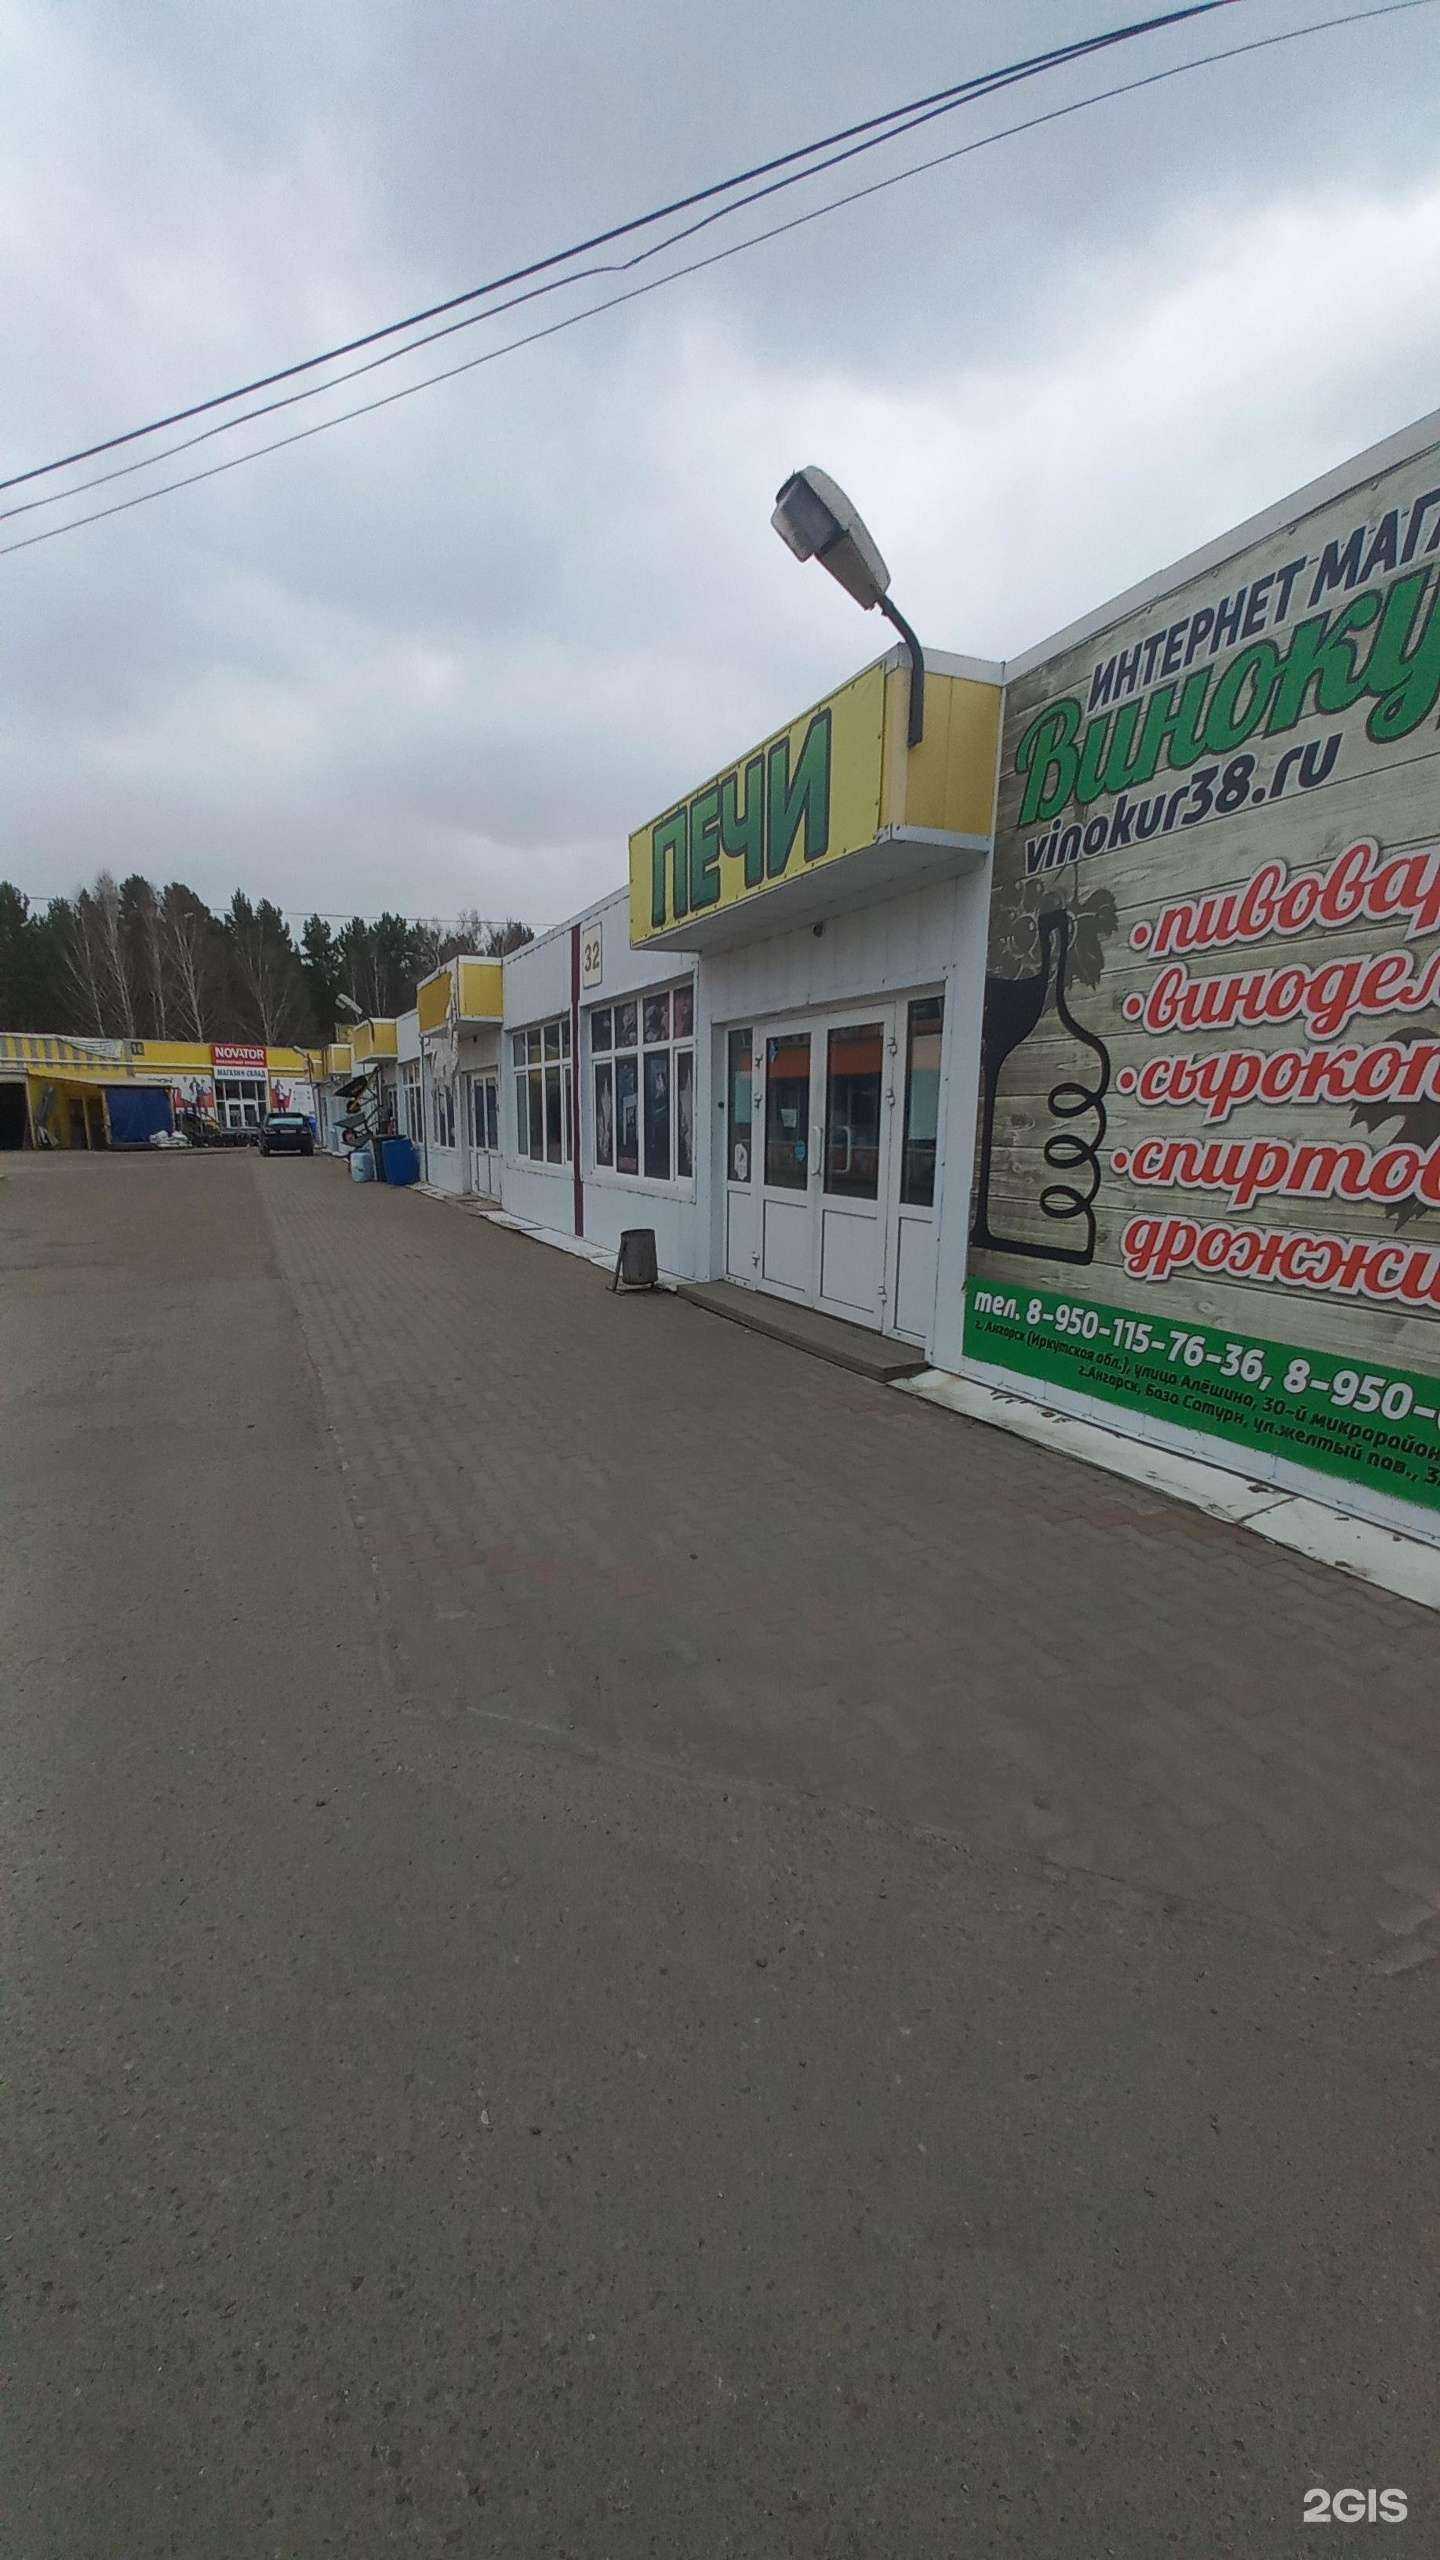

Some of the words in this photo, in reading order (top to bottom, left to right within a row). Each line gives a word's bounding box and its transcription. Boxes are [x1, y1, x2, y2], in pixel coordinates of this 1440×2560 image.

[1087, 556, 1306, 712] ИНТЕРНЕТ
[651, 707, 832, 928] ПЕЧИ
[1026, 733, 1343, 876] vinokur38.ru
[584, 940, 600, 972] 32
[214, 1046, 265, 1060] NOVATOR
[974, 1291, 1020, 1321] тел.
[1026, 1298, 1272, 1392] 8-950-115-76-36,
[1283, 1358, 1440, 1430] 8-950-
[1425, 1466, 1440, 1486] 3
